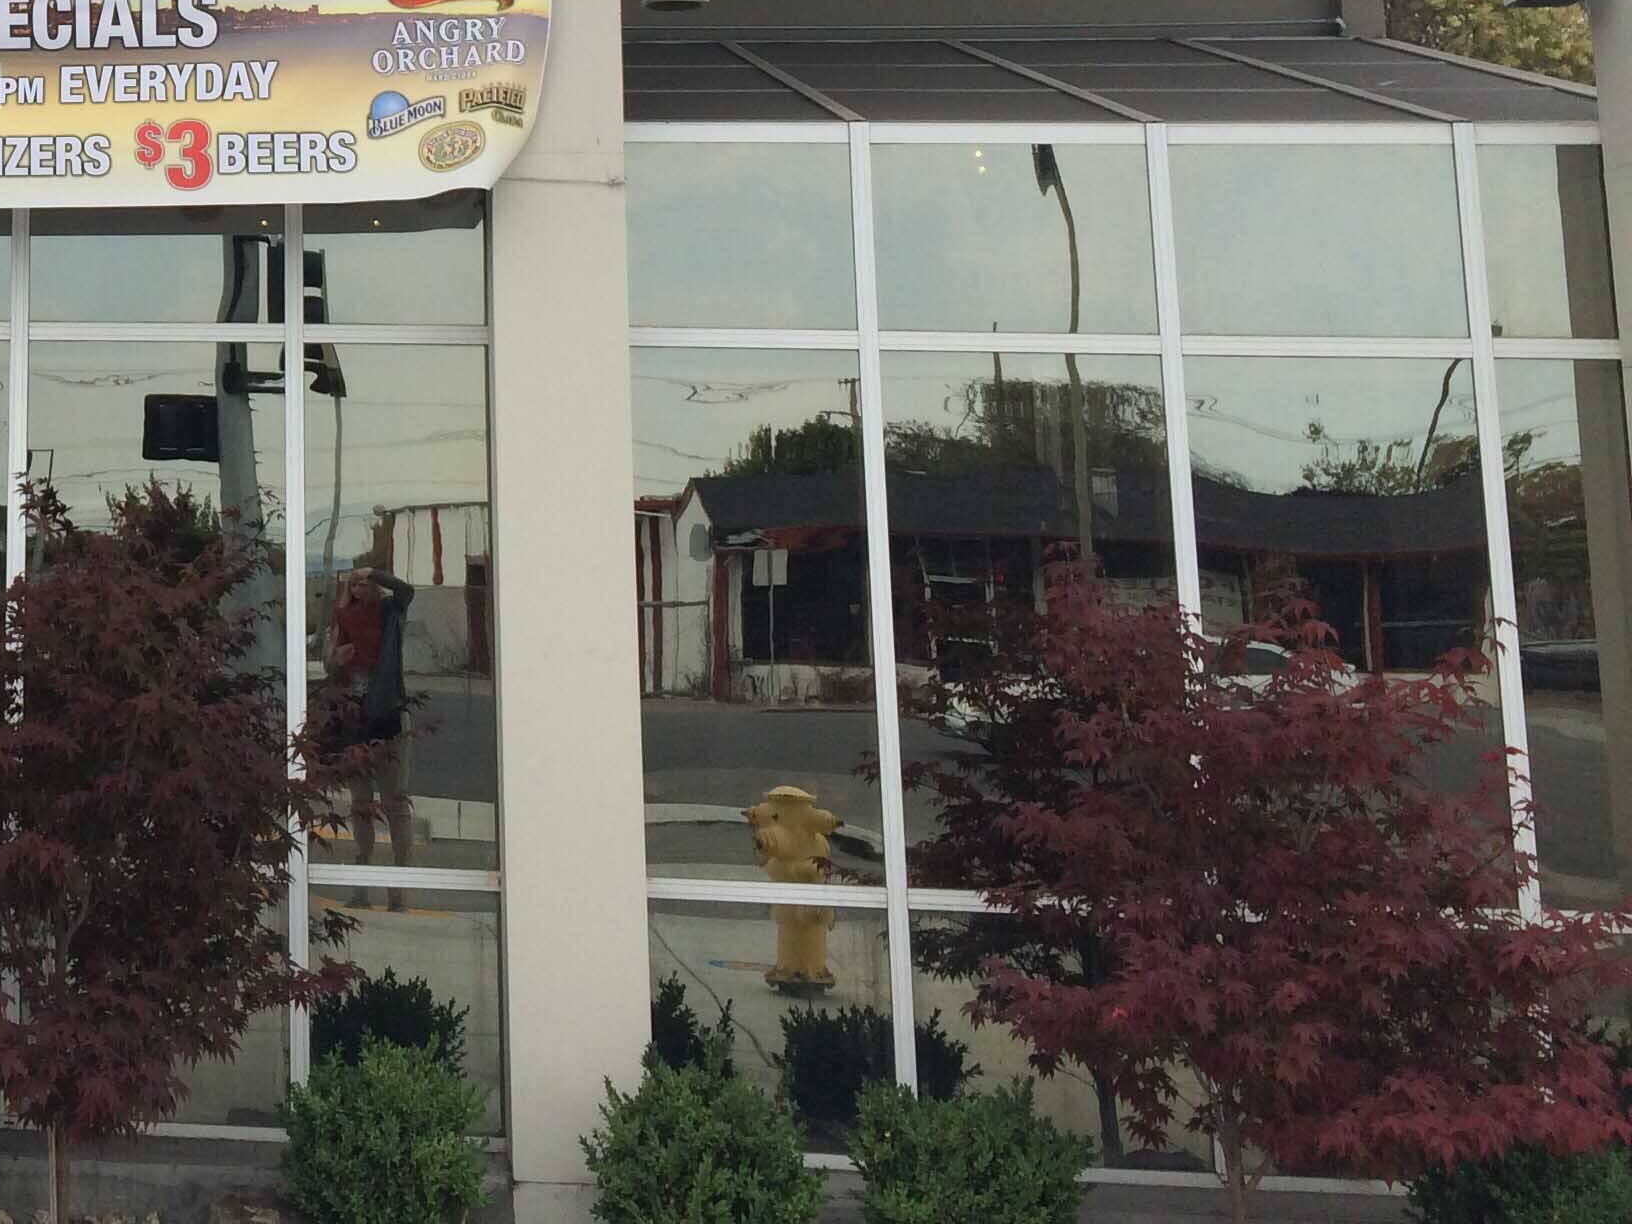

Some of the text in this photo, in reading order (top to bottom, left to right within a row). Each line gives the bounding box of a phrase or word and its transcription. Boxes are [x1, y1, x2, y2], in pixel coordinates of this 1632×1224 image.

[392, 17, 505, 44] ANGRY
[372, 40, 526, 74] ORCHARD
[59, 61, 279, 104] EVERYDAY
[370, 100, 442, 136] BLUE MOON
[135, 119, 213, 191] $3
[217, 131, 358, 175] BEERS
